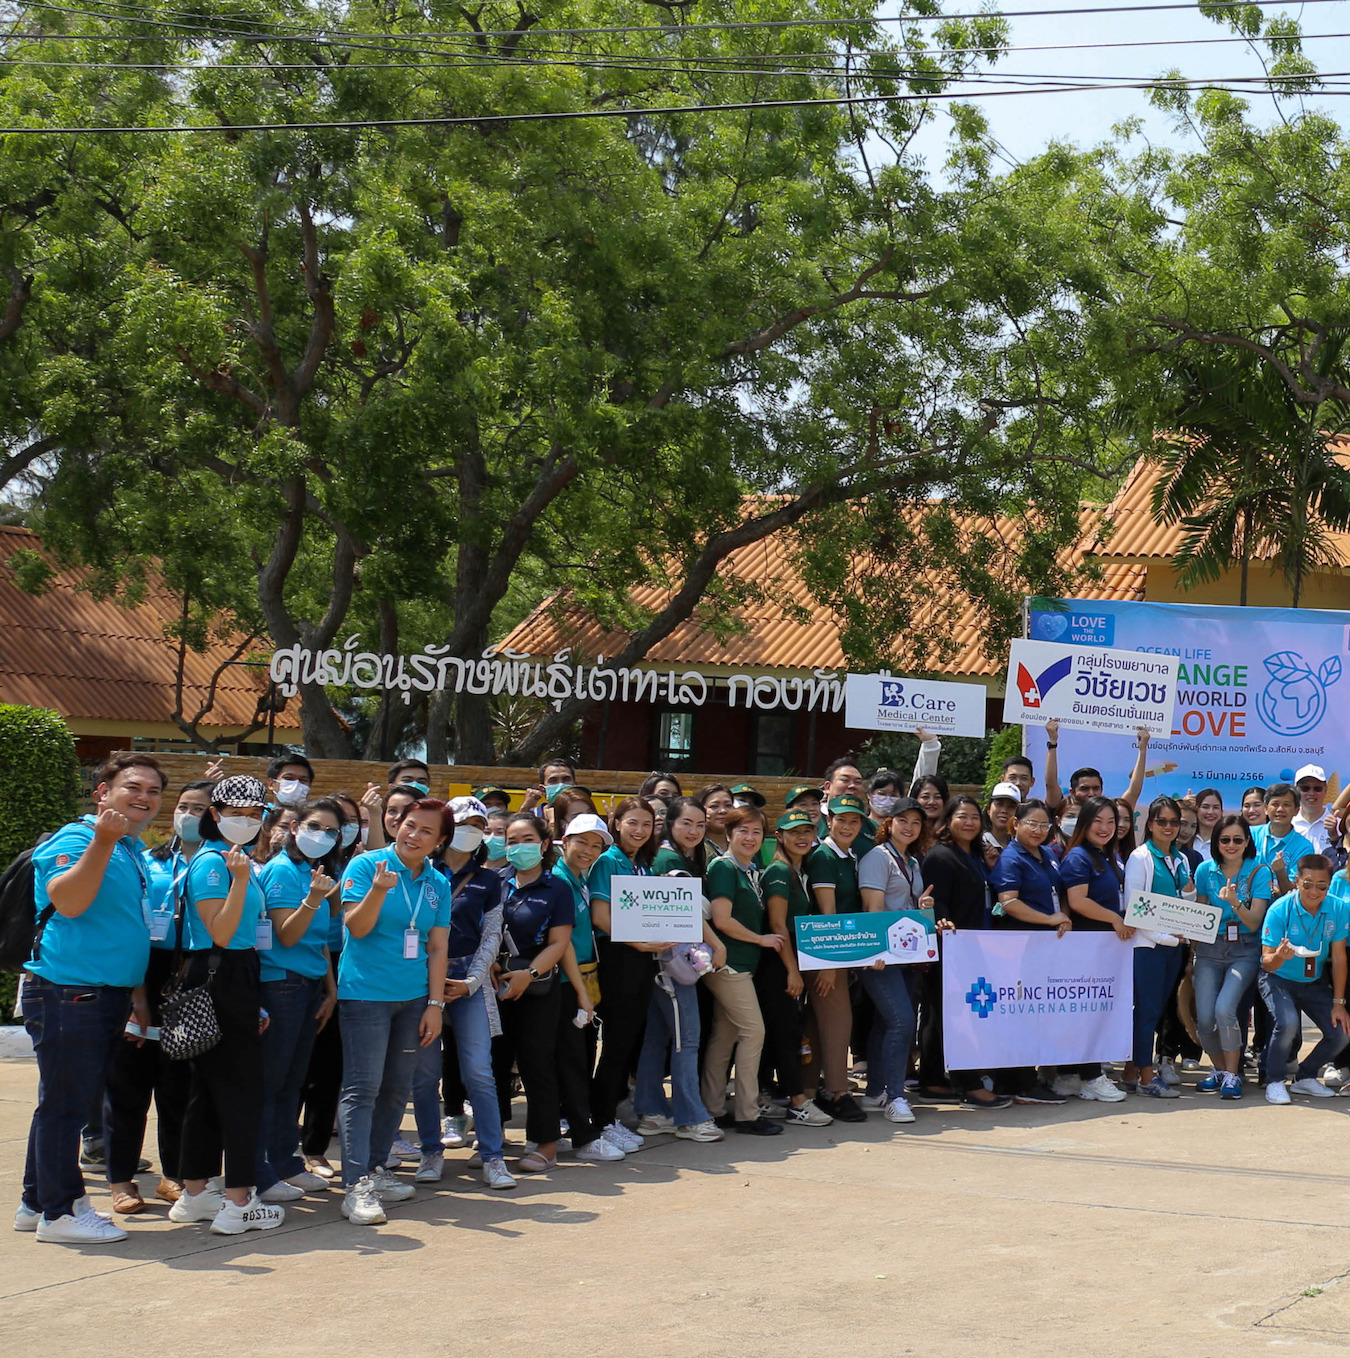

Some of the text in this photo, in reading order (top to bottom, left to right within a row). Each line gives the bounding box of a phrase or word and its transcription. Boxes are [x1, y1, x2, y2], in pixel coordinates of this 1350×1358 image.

[1071, 616, 1106, 628] LOVE
[1071, 634, 1105, 642] WORLD
[1185, 649, 1211, 660] LIFE
[1077, 653, 1169, 675] กลุ่มโรงพยาบาล
[270, 633, 707, 712] ศูนย์อนุรักษ์พันธุ์เต่าทะเล
[1177, 664, 1248, 687] ANGE
[1075, 670, 1167, 704] วิชัยเวช
[878, 681, 956, 711] B.Care
[1177, 690, 1247, 708] WORLD
[877, 709, 956, 723] Medical Center
[1072, 701, 1164, 722] อินเตอร์เนชั่นแนล
[1171, 711, 1246, 737] OVE
[1192, 770, 1264, 781] 15 มีนาคม 2566
[642, 887, 692, 903] พญาไท
[642, 904, 693, 912] PHYATHAI
[1162, 902, 1206, 916] PHYATHAI
[1203, 912, 1216, 930] 3
[1047, 985, 1114, 1000] HOSPITAL
[1000, 1001, 1113, 1014] SUVARNABHUMI
[243, 1208, 280, 1222] BOSTON
